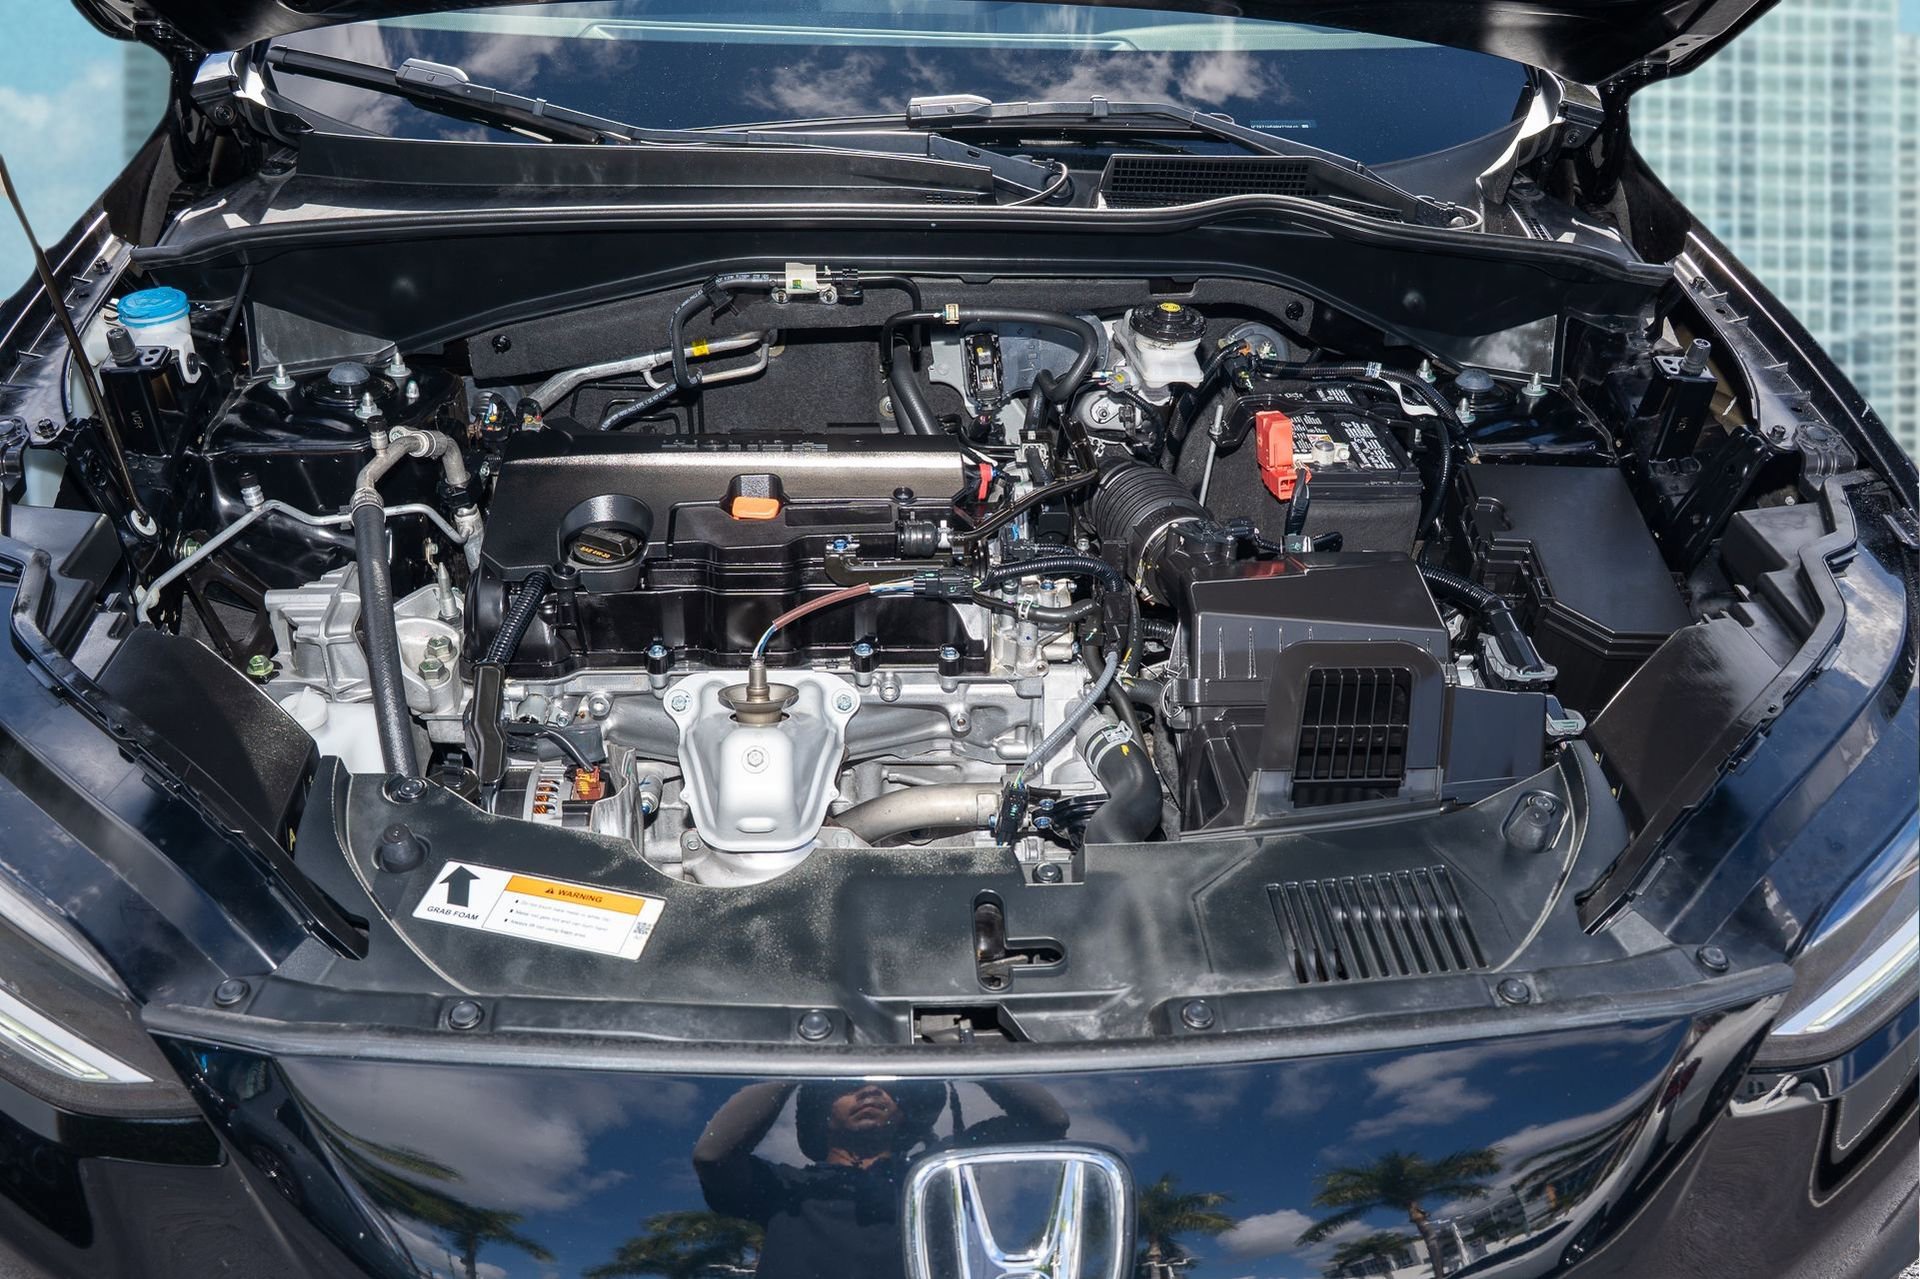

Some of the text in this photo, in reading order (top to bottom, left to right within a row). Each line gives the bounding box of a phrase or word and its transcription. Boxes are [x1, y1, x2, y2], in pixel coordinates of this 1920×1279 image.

[558, 889, 603, 903] WARNING
[427, 905, 480, 920] GRAB FOAM
